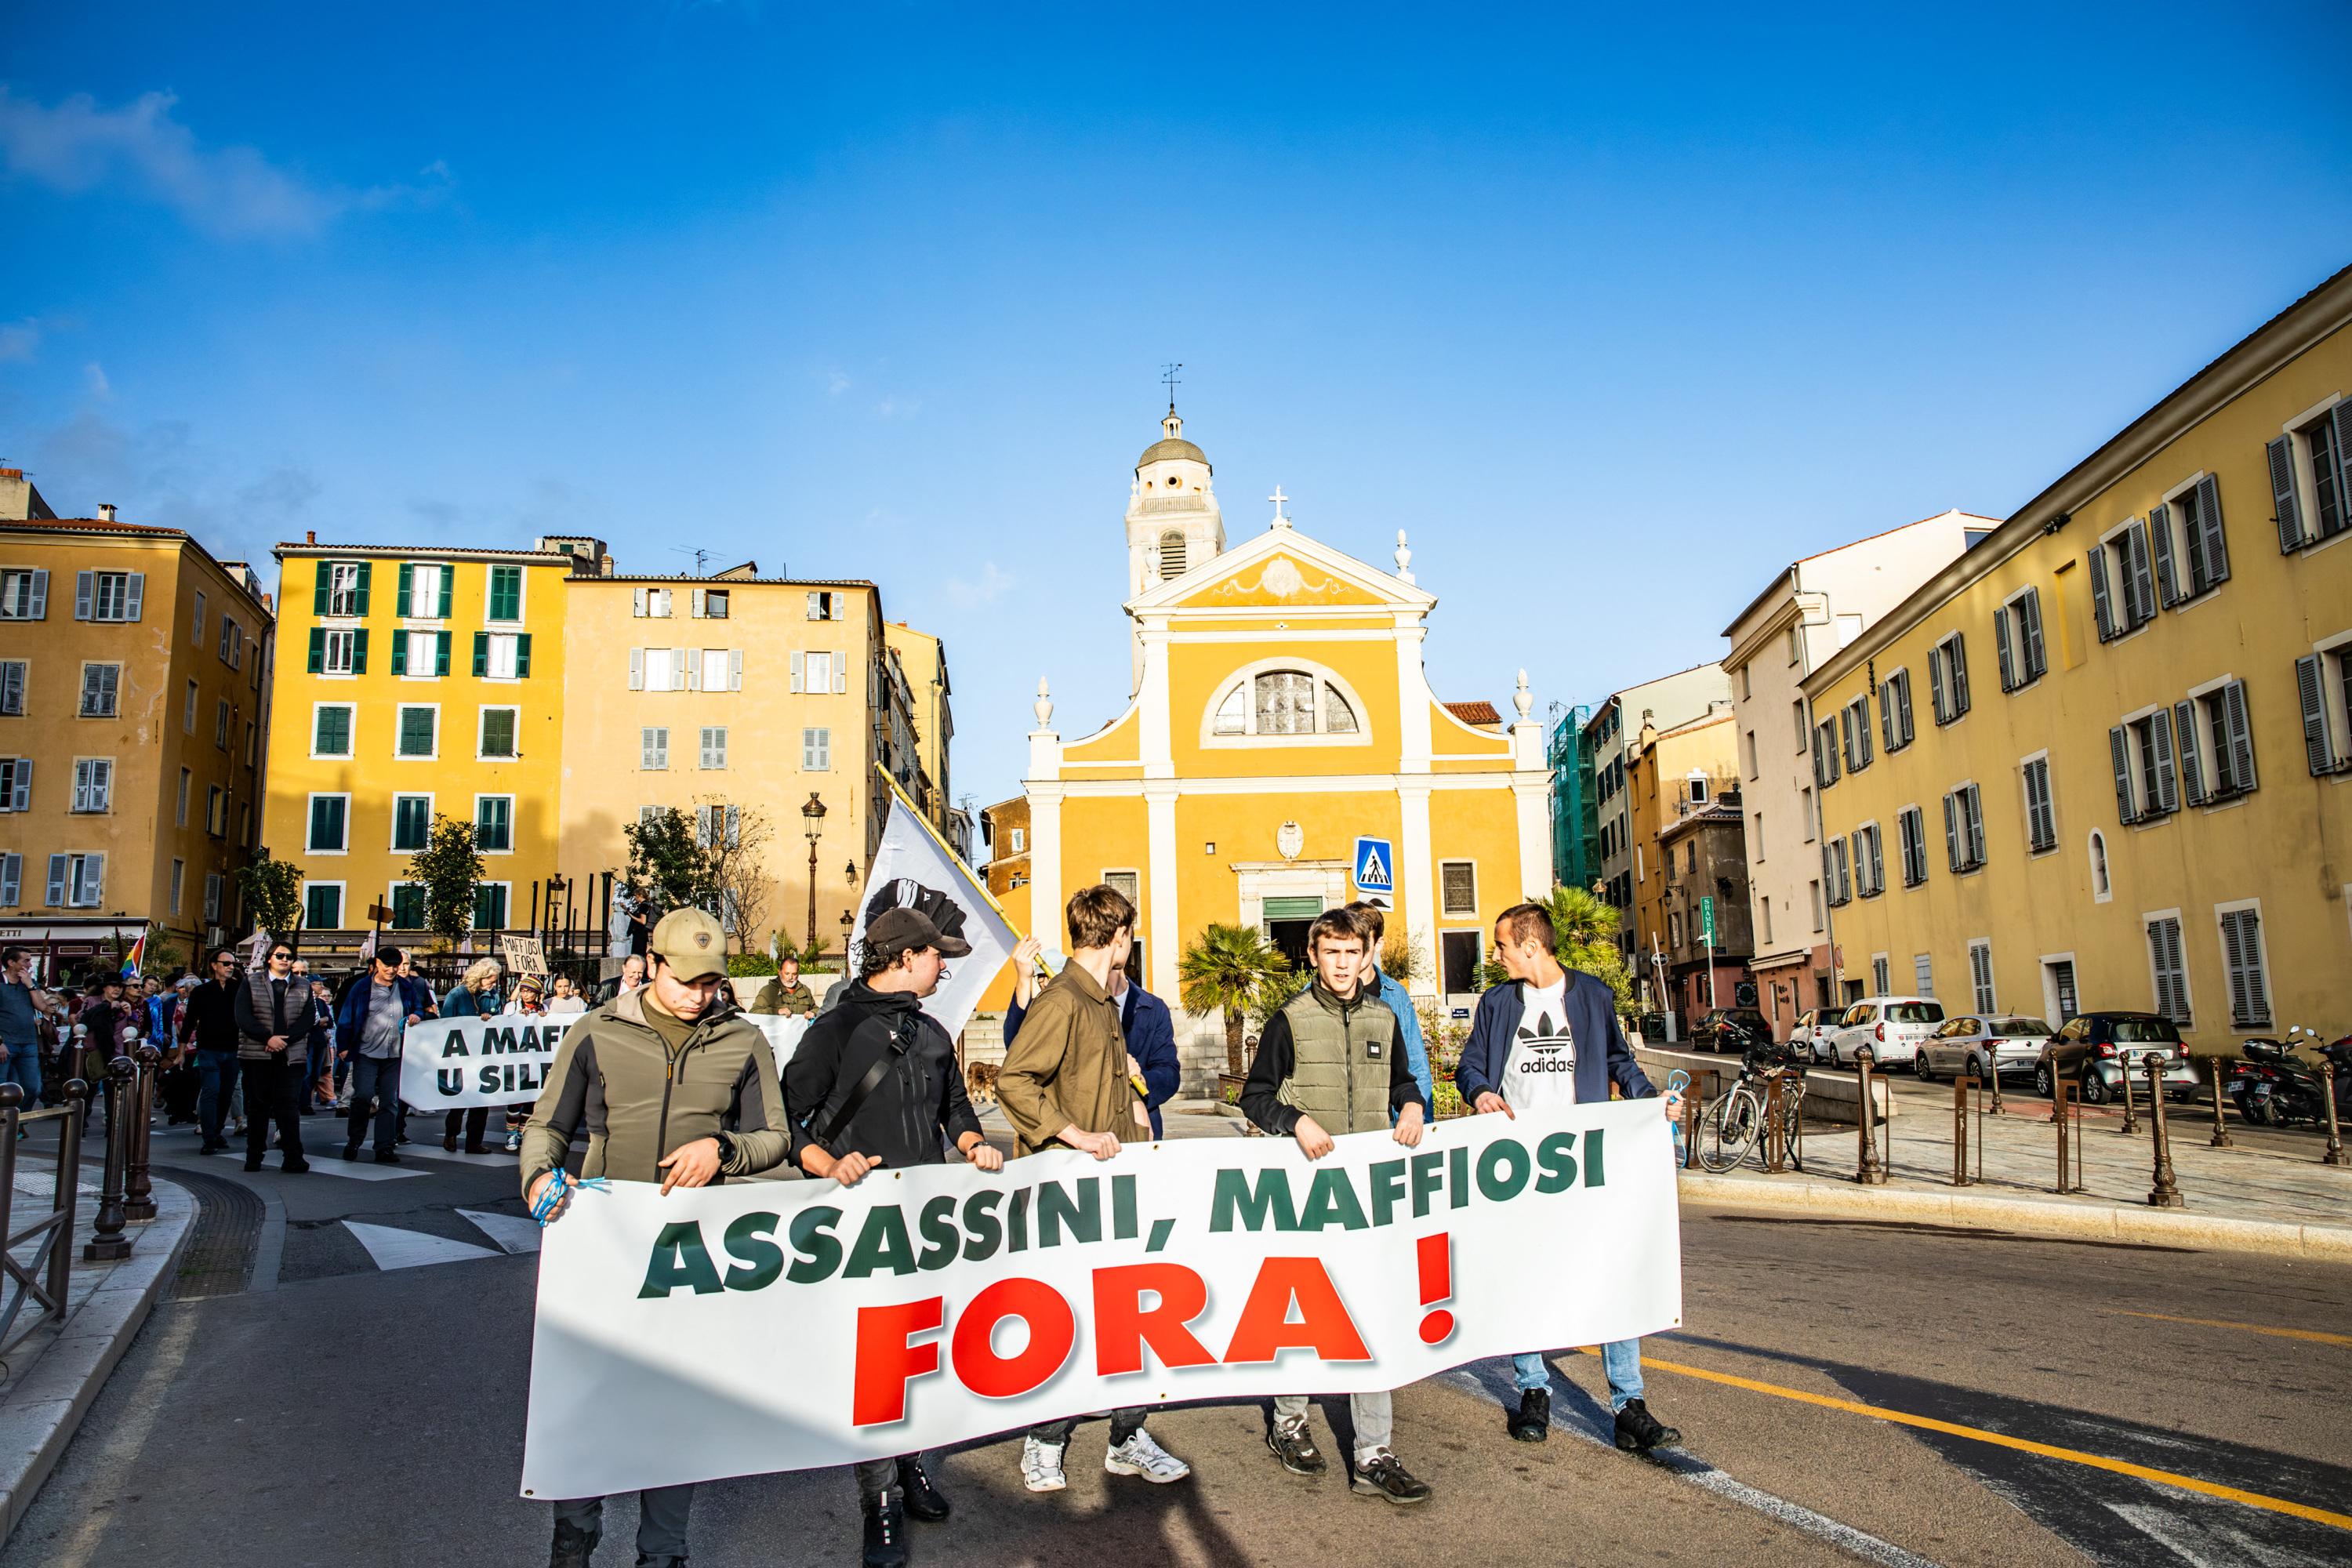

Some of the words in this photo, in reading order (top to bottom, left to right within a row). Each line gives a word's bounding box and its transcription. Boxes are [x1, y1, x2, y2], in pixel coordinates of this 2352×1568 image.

[1704, 899, 1712, 932] SHAMRO
[504, 937, 541, 955] MAFFIOSI
[514, 954, 540, 972] FORA
[441, 1029, 470, 1058] A
[1521, 1057, 1574, 1073] adidas
[437, 1067, 463, 1097] U
[637, 1174, 1177, 1300] ASSASSINI,
[1208, 1128, 1606, 1234] MAFFIOSI
[852, 1256, 1374, 1428] FORA
